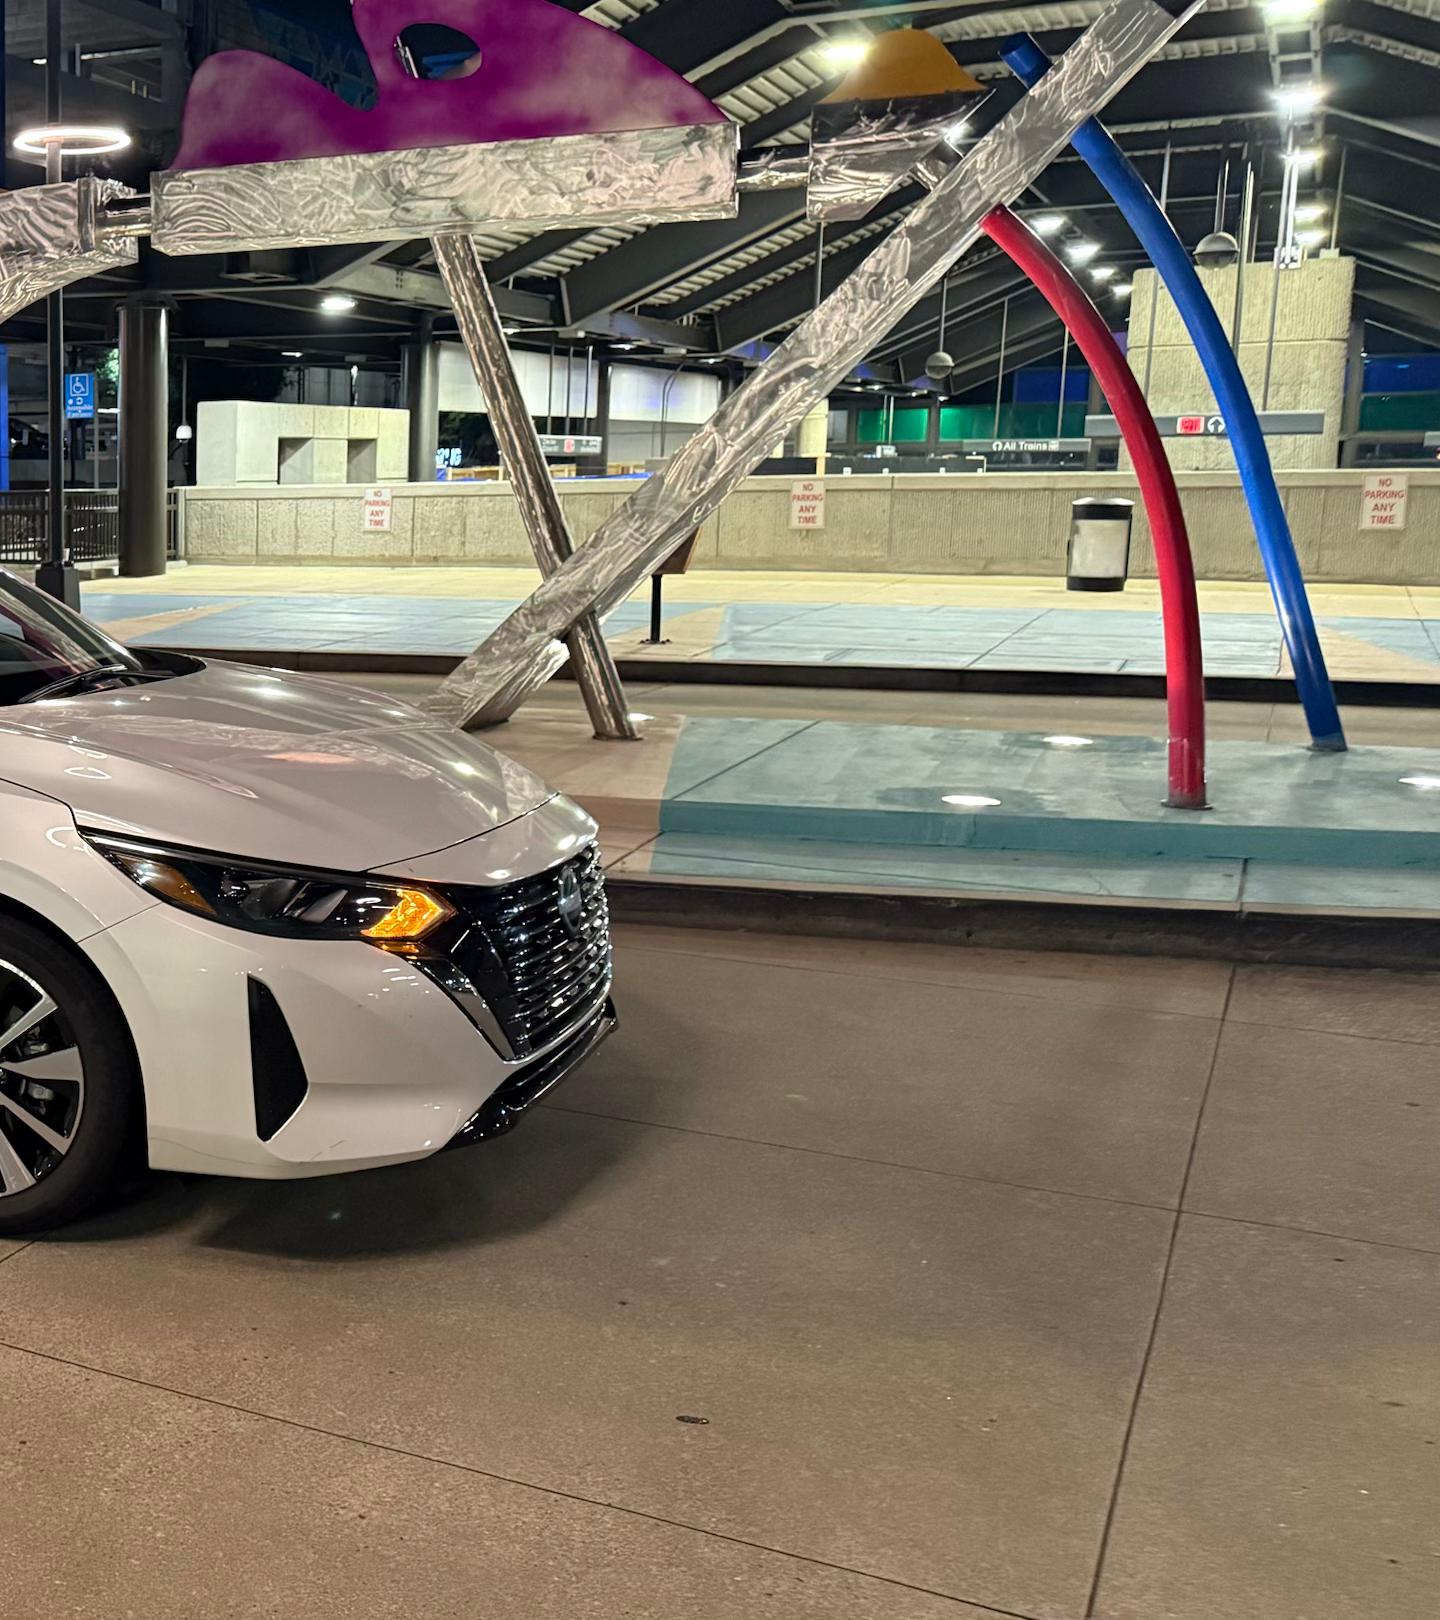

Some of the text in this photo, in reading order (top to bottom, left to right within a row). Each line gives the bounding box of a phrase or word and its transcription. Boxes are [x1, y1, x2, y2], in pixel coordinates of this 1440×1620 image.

[1003, 441, 1048, 451] All Trains
[803, 483, 814, 491] NO
[1379, 479, 1392, 487] NO
[1365, 490, 1404, 499] PARKING
[799, 505, 816, 513] ANY
[1372, 503, 1396, 512] ANY
[369, 519, 384, 527] TIME
[798, 516, 816, 524] TIME
[1371, 515, 1395, 524] TIME
